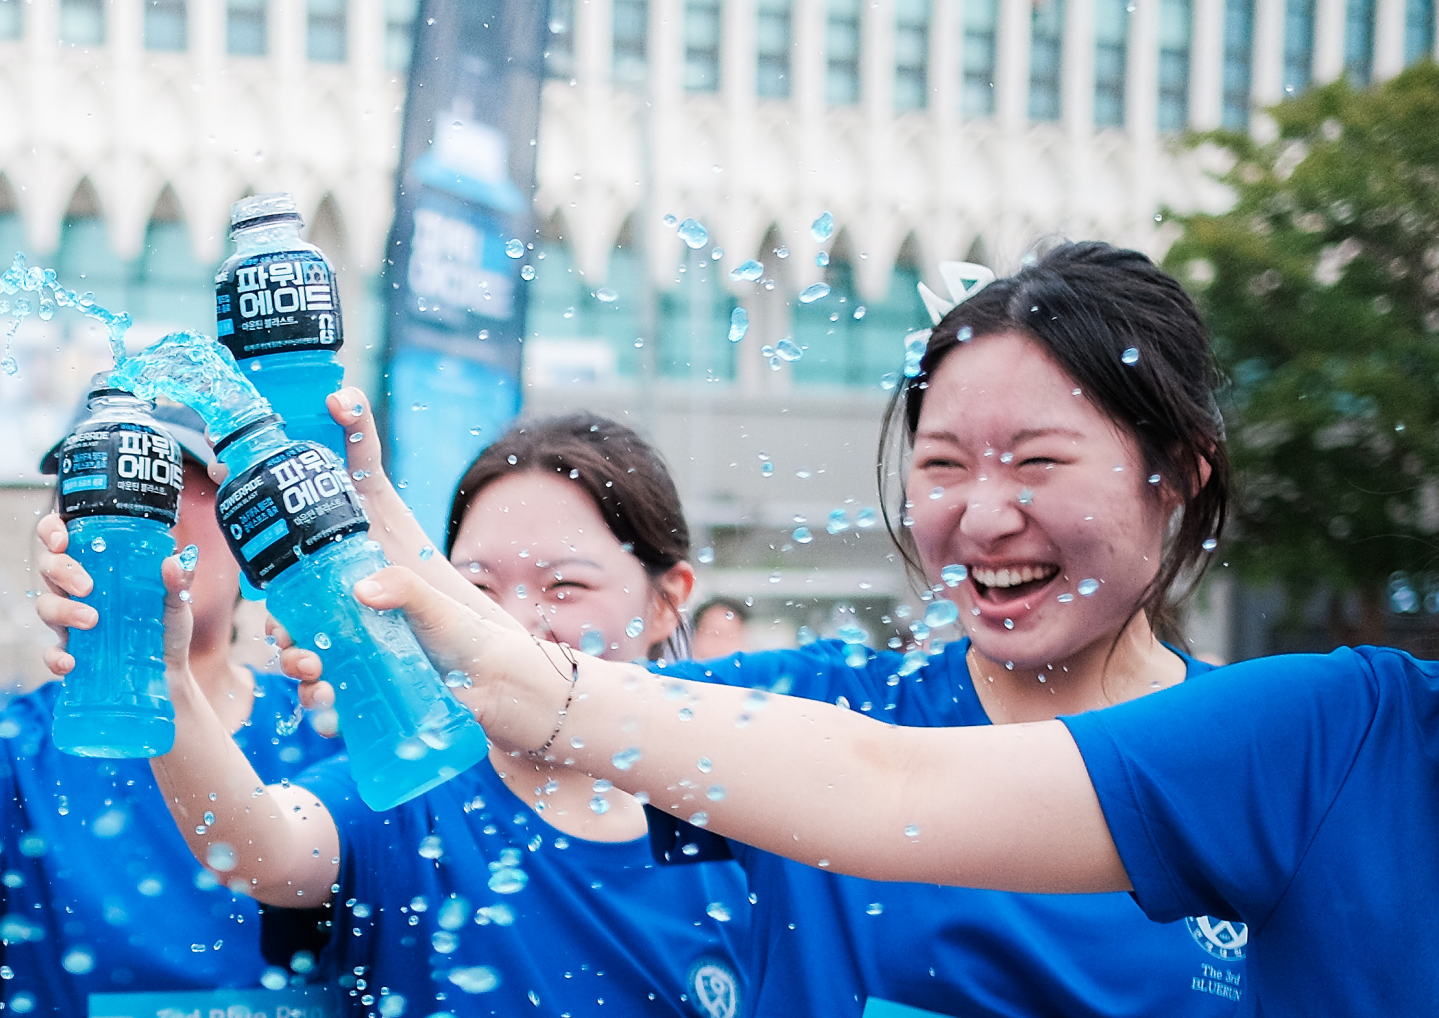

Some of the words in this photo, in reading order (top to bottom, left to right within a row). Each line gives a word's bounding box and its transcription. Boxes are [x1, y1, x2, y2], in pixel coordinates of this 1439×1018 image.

[236, 262, 305, 293] 파워
[240, 285, 333, 318] 에이드
[118, 455, 182, 491] 에이드
[220, 476, 264, 514] POWERADE
